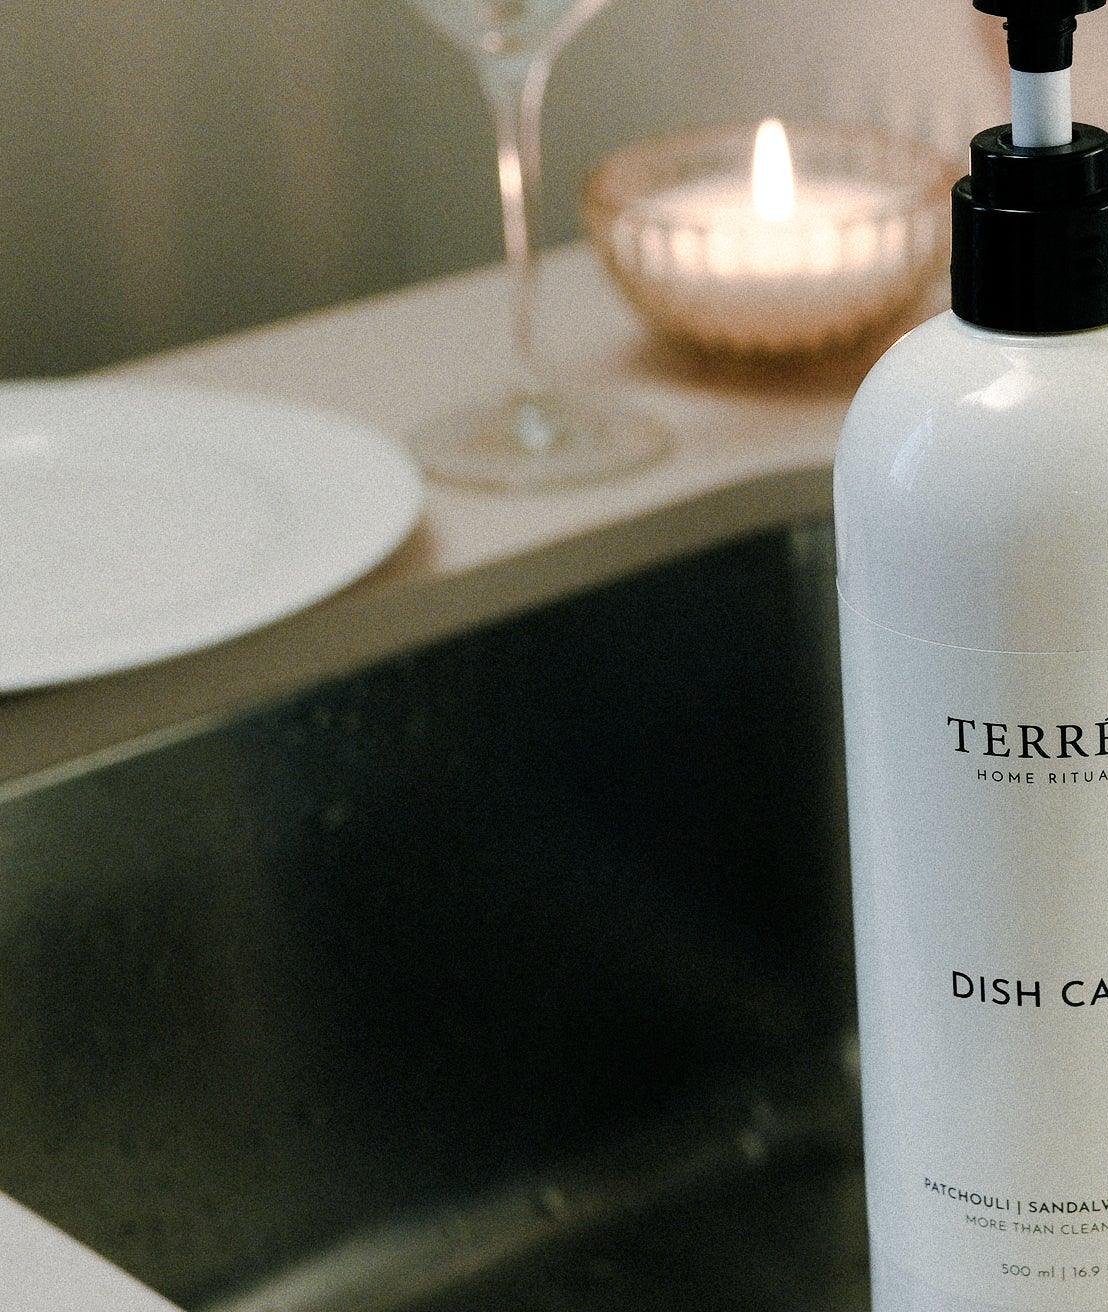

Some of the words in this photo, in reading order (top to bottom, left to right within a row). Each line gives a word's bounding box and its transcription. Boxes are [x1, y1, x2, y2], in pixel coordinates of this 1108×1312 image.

[977, 769, 1034, 784] HOME
[952, 970, 1041, 1008] DISH
[924, 1176, 1010, 1211] PATCHOULI
[966, 1214, 1007, 1232] MORE
[1013, 1221, 1054, 1235] THAN
[1001, 1263, 1031, 1277] 500
[1038, 1266, 1055, 1278] ml
[1073, 1265, 1100, 1278] 16.9
